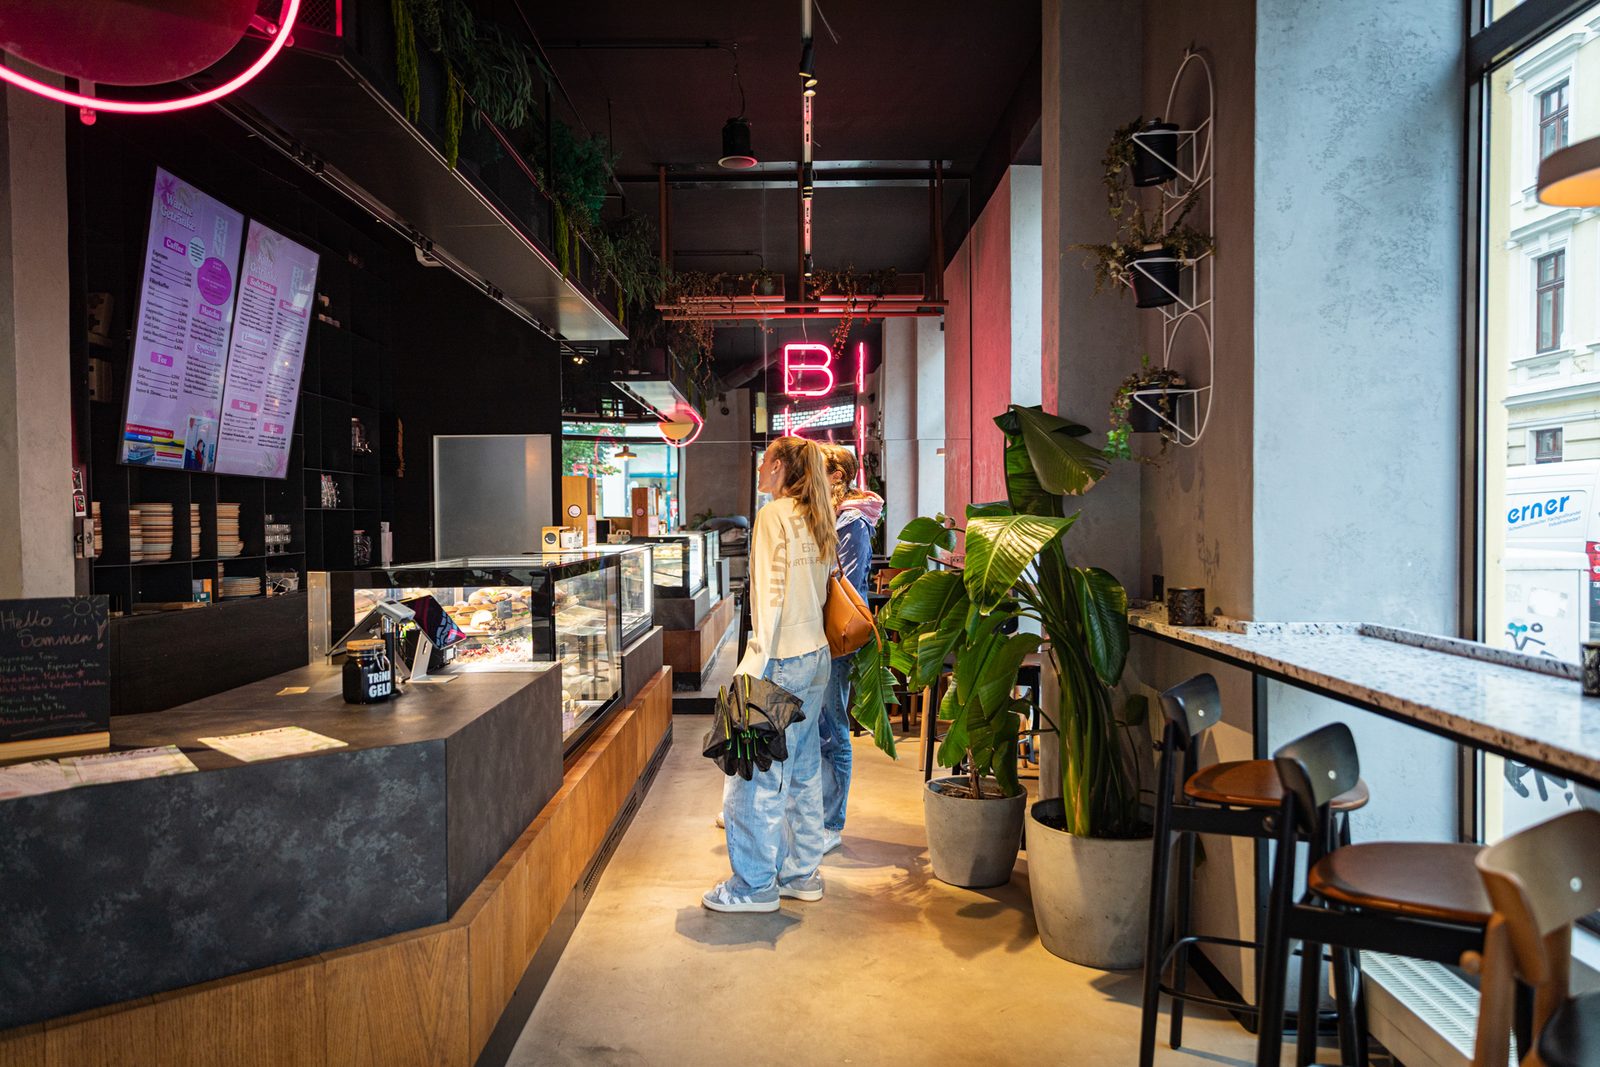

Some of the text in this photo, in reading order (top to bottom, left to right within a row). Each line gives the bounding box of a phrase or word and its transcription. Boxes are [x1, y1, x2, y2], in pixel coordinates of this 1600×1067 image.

[784, 342, 864, 396] BI
[1507, 495, 1570, 524] erner
[1, 609, 53, 631] Hello
